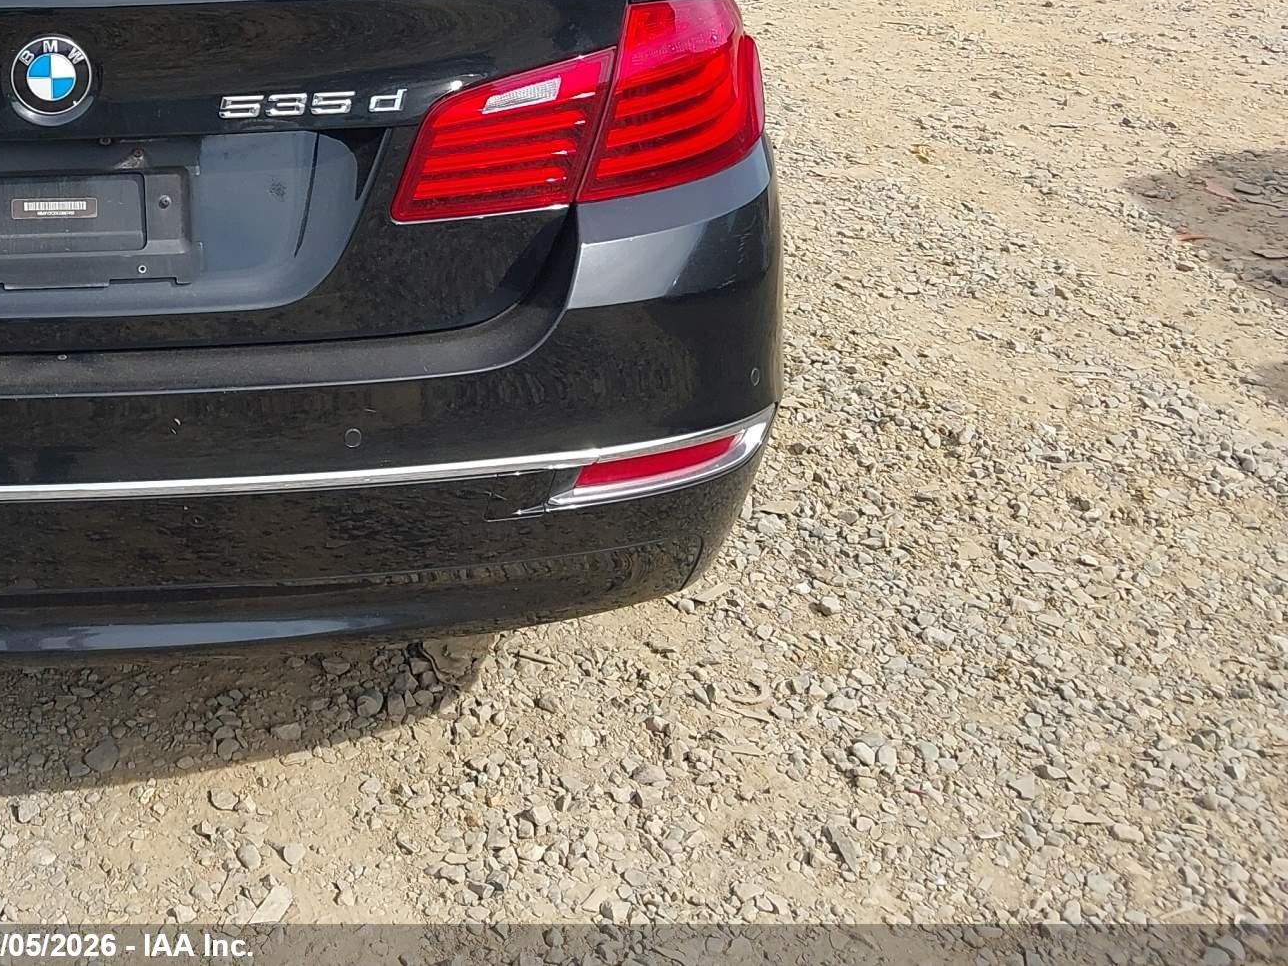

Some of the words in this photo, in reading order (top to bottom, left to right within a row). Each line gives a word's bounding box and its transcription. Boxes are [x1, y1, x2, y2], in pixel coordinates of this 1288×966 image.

[18, 39, 85, 66] BMW
[218, 90, 356, 119] 535
[369, 88, 408, 112] d
